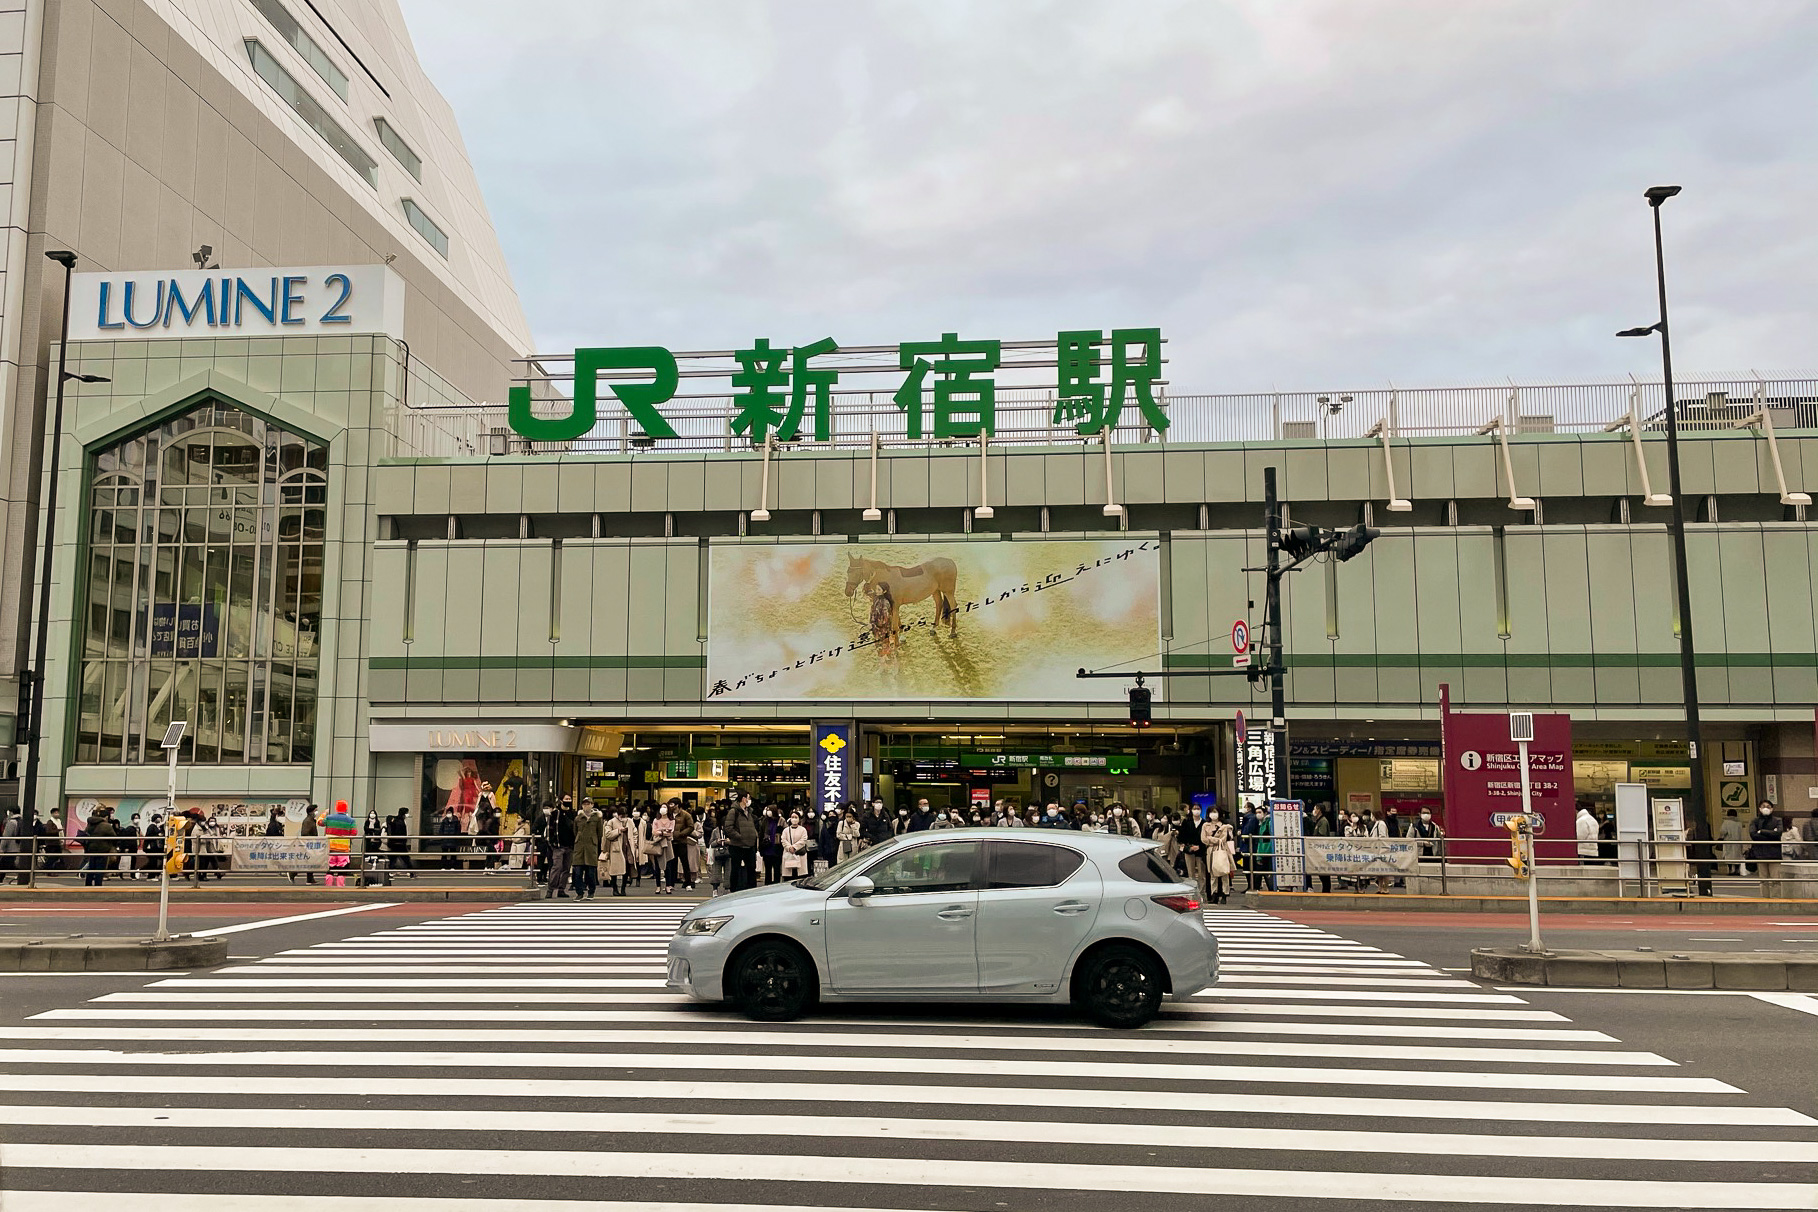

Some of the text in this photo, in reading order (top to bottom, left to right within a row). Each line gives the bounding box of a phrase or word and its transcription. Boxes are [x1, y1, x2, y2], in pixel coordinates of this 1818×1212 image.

[97, 273, 352, 330] LUMINE 2
[508, 327, 1171, 444] JR 新宿駅
[428, 730, 517, 749] LUMINE 2
[992, 755, 1006, 764] JR
[1247, 731, 1264, 791] 三角広場
[1486, 753, 1563, 763] 新宿区エアマップ
[1486, 763, 1516, 771] Shinjuku
[1549, 763, 1564, 771] Map
[1487, 781, 1558, 789] 新宿区新宿丁目 38-2
[1531, 790, 1543, 798] City
[1273, 803, 1300, 811] お知らせ
